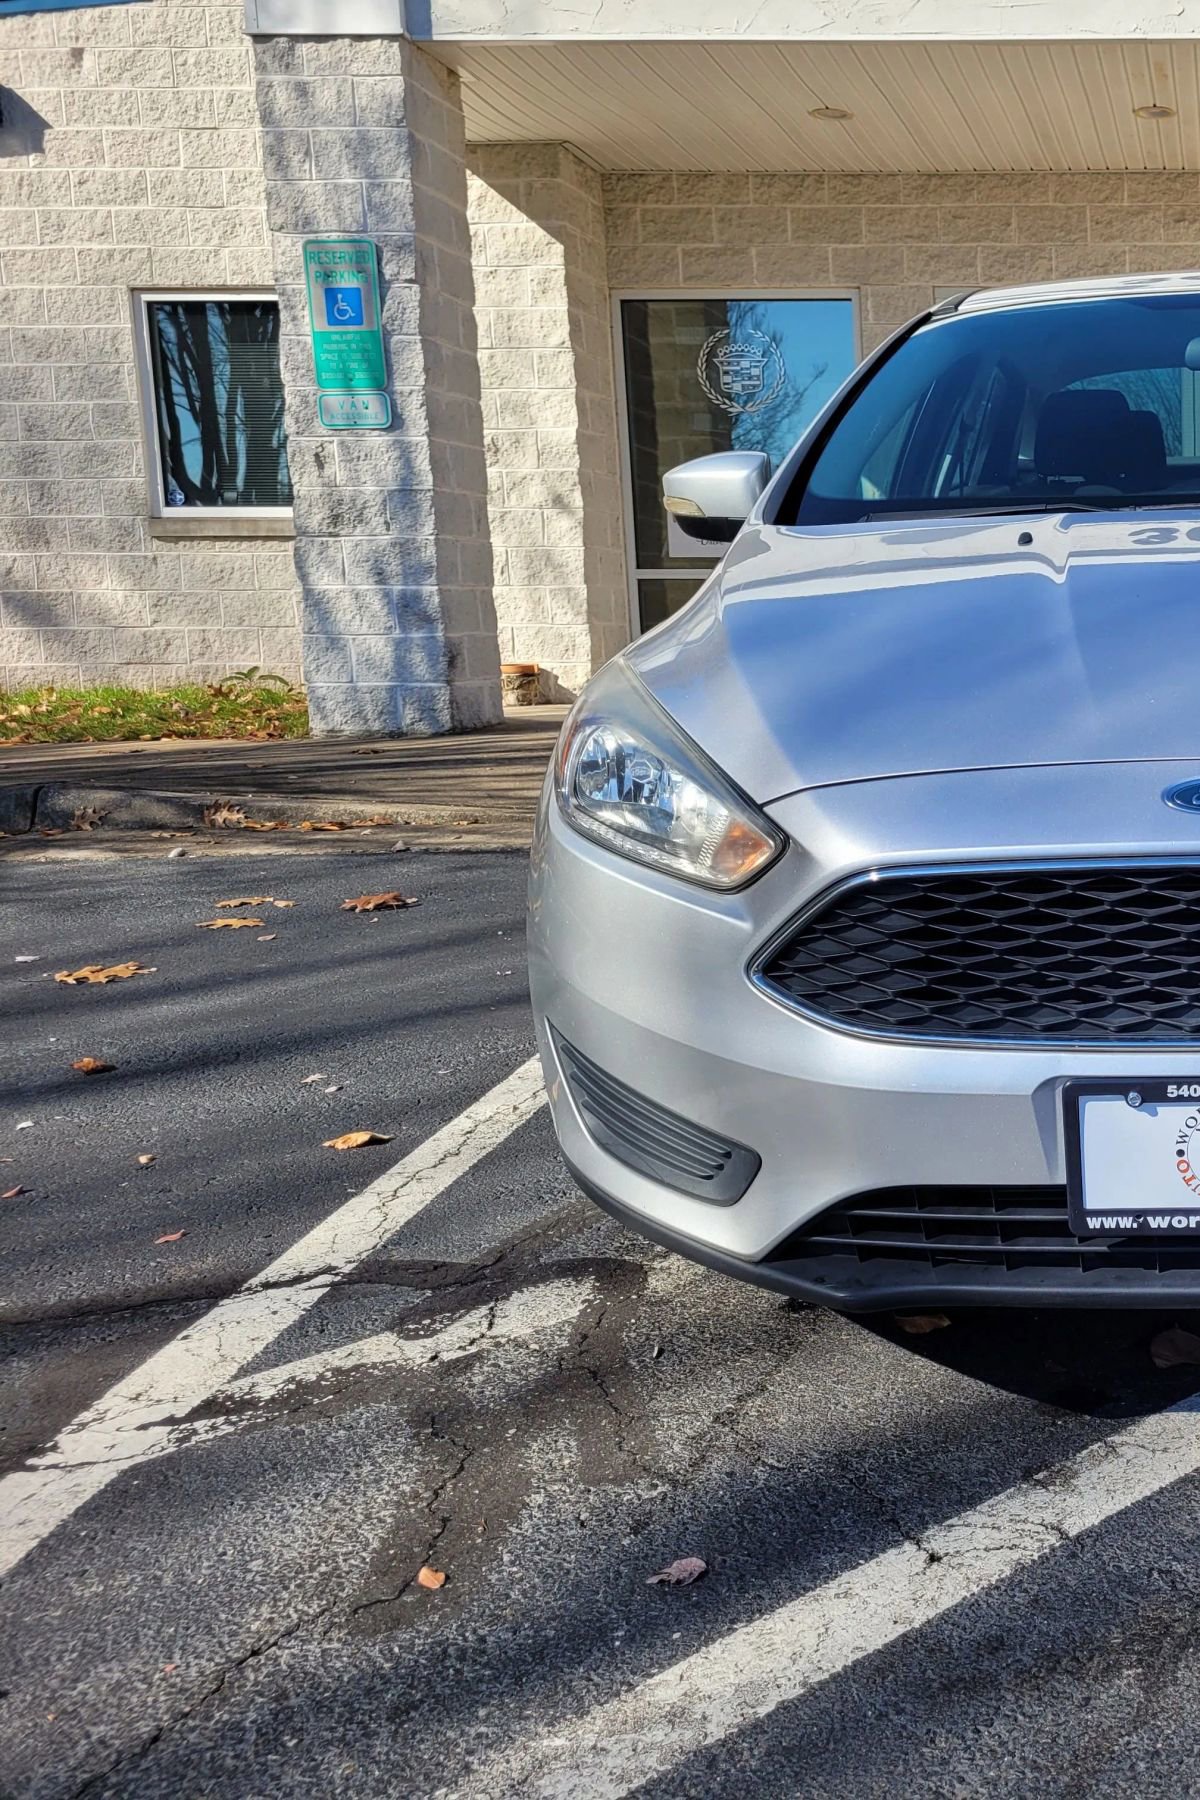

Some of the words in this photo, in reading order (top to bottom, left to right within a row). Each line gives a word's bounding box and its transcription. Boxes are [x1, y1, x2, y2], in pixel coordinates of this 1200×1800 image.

[308, 249, 370, 264] RESERVED
[314, 270, 369, 284] PARKING
[338, 399, 369, 410] VAN
